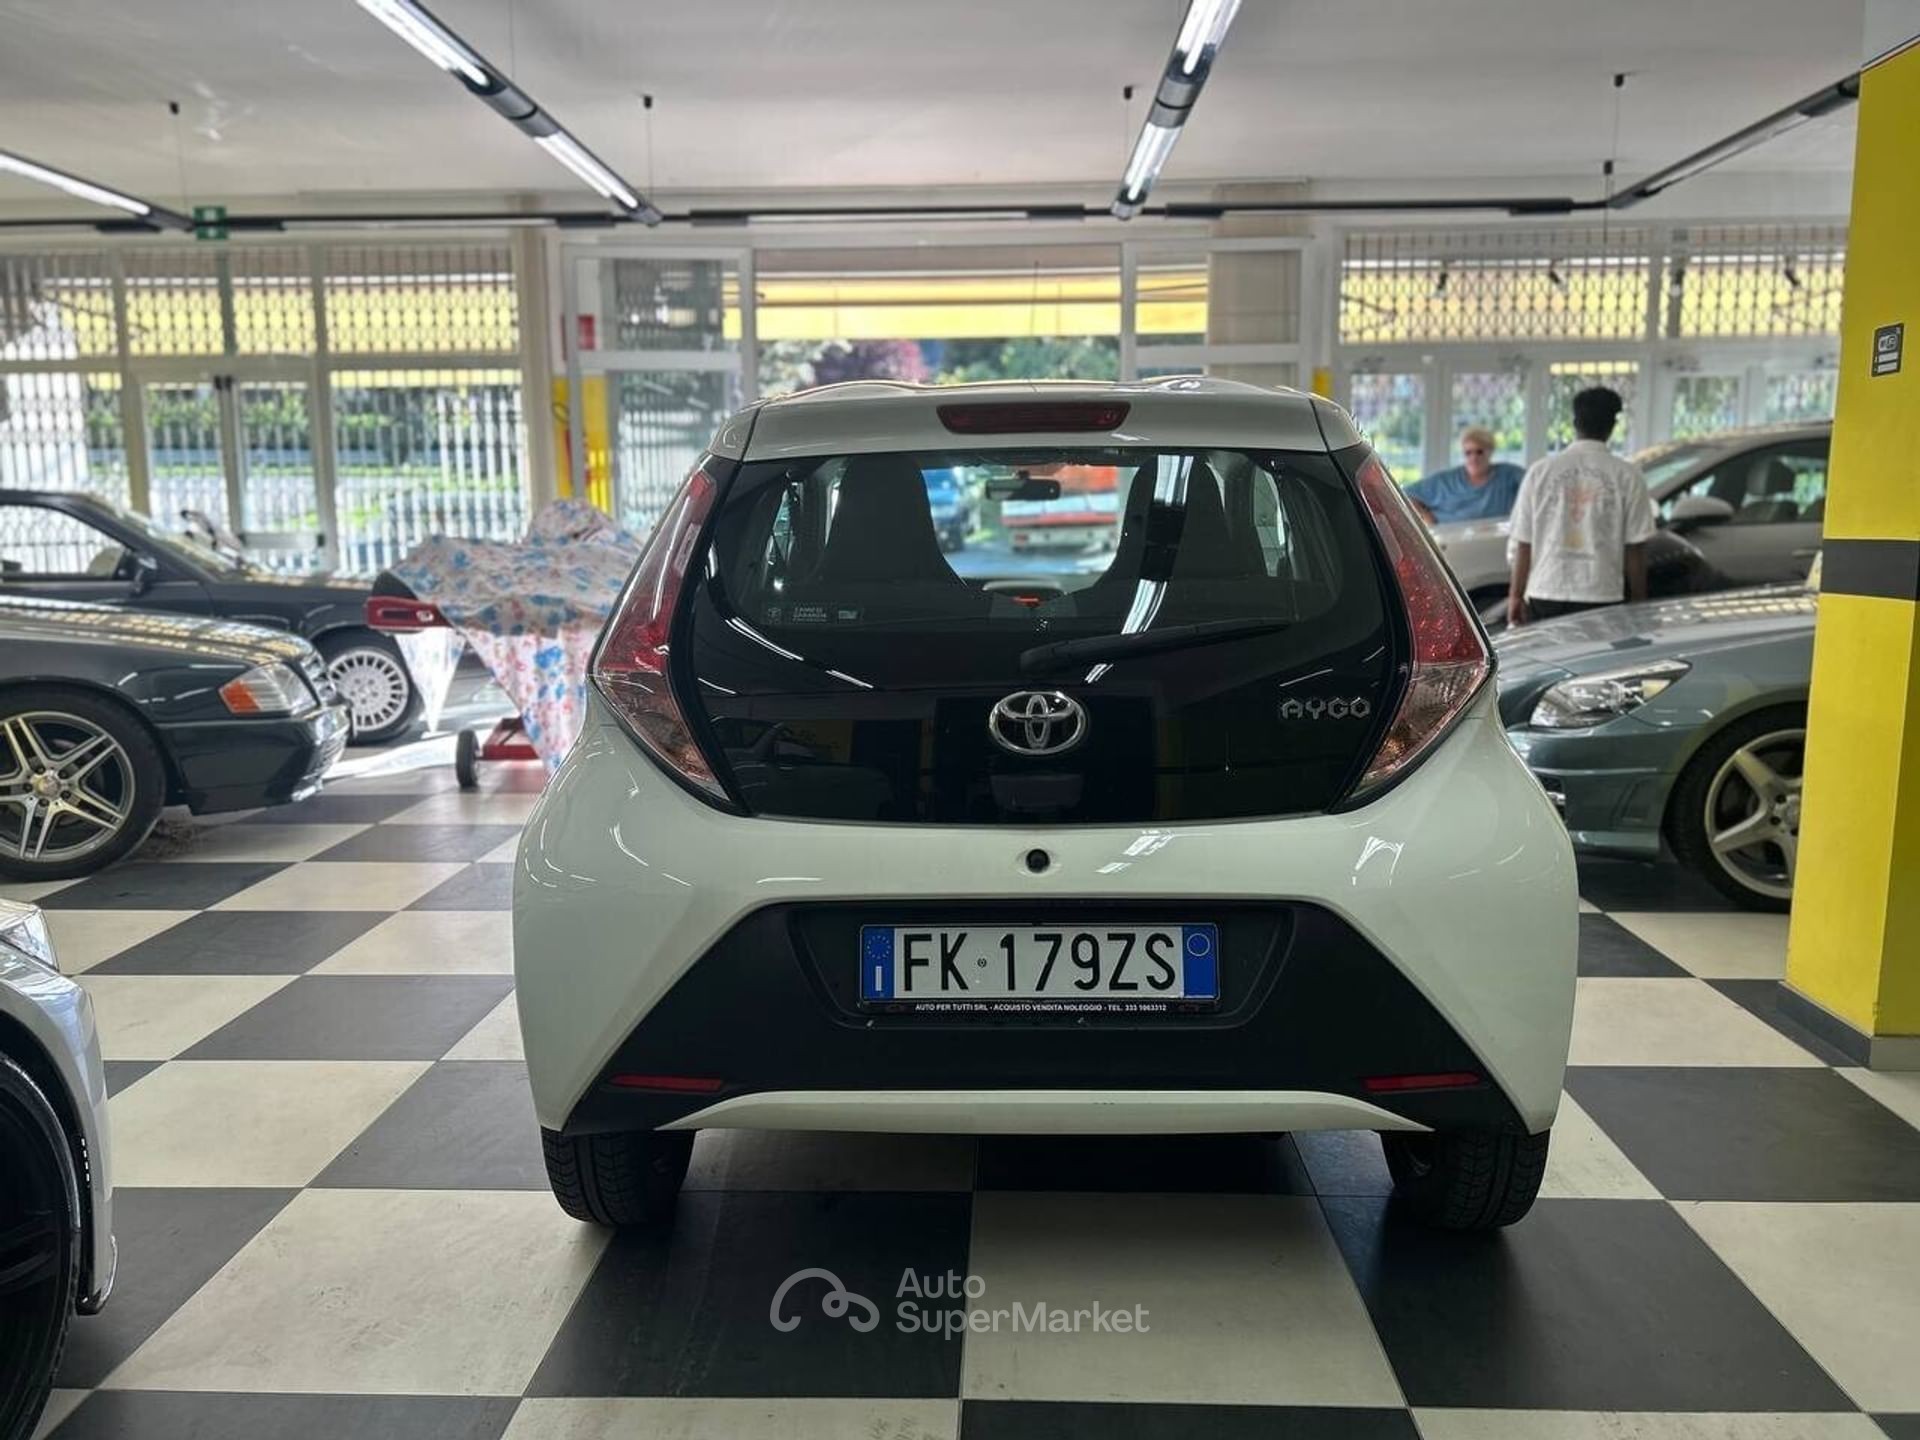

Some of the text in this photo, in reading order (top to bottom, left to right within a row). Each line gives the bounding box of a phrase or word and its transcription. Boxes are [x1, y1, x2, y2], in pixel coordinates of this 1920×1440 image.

[1280, 697, 1371, 720] AYGO
[903, 932, 1176, 992] FK 179ZS
[915, 1003, 935, 1011] AUTO
[936, 1003, 951, 1011] PER
[952, 1003, 973, 1011] TUTTI
[974, 1003, 988, 1011] SRL
[993, 1003, 1031, 1011] ACQUISTO
[1032, 1003, 1063, 1011] VENDITA
[1064, 1003, 1102, 1011] NOLEGGIO
